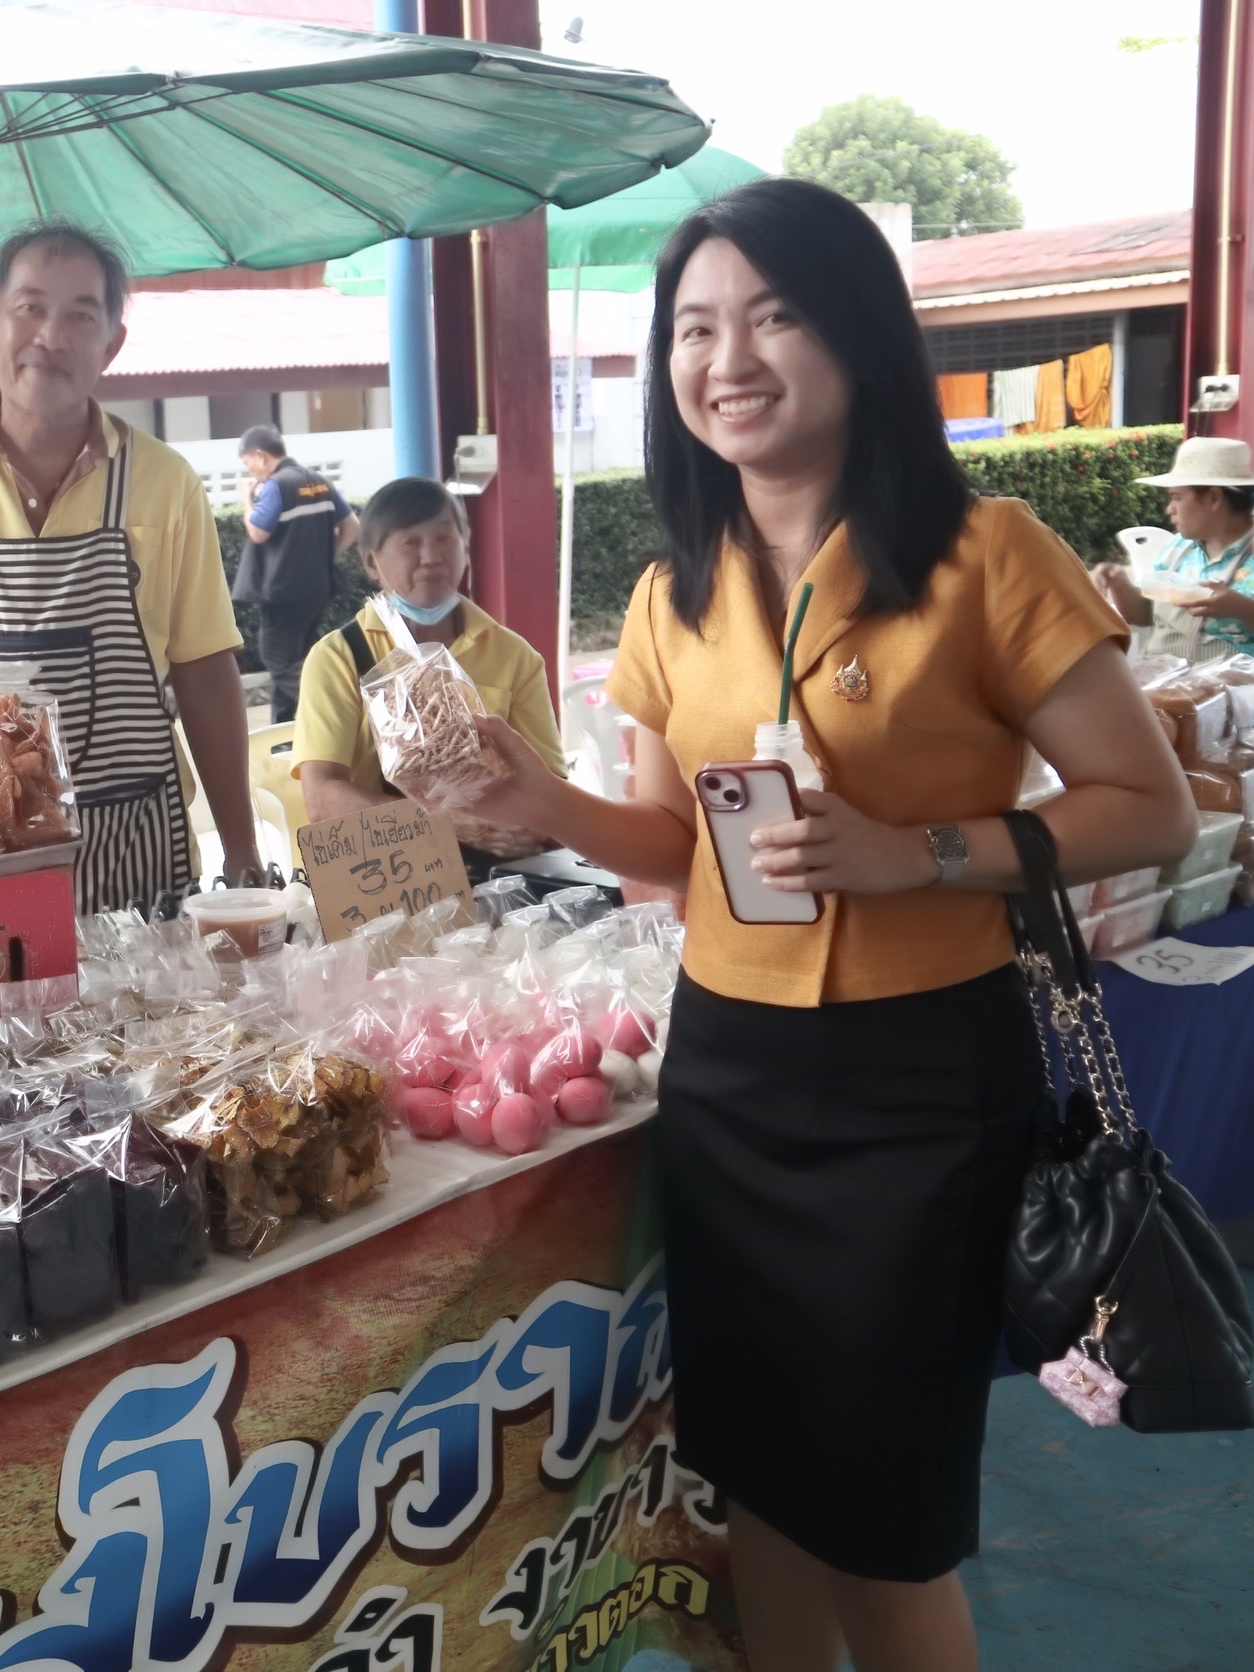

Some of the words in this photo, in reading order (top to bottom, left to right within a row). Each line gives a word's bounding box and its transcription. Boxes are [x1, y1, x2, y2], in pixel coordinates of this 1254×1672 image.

[349, 849, 414, 895] 35
[340, 905, 368, 932] 3
[399, 882, 443, 917] 100
[1135, 949, 1195, 975] 35
